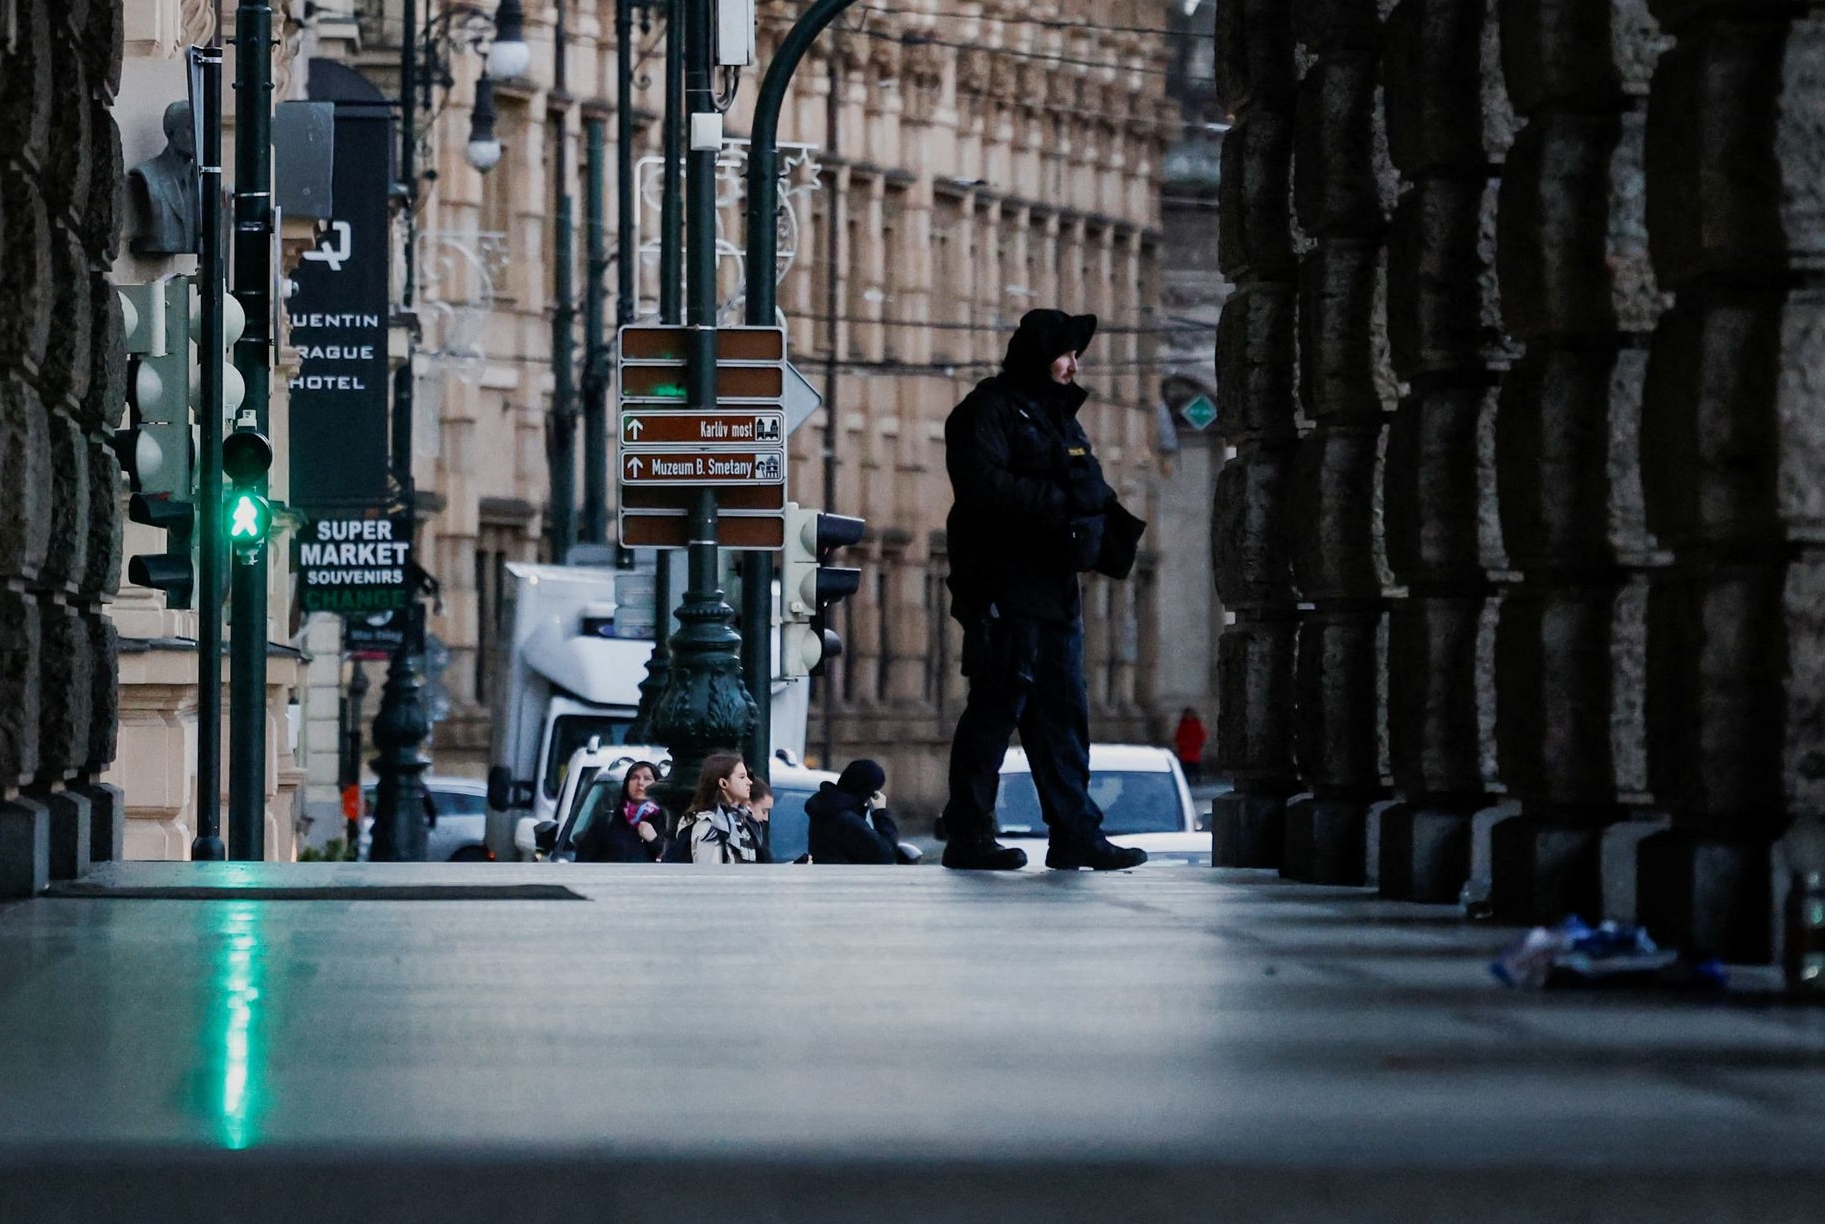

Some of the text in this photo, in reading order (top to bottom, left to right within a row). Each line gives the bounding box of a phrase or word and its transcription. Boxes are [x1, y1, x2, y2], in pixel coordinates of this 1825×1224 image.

[292, 313, 379, 328] UENTIN
[296, 345, 374, 360] RAGUE
[289, 376, 365, 390] HOTEL
[700, 420, 753, 438] Karlův most
[652, 458, 752, 479] Muzeum B. Smetany
[317, 520, 392, 541] SUPER
[300, 543, 409, 566] MARKET
[307, 570, 403, 585] SOUVENIRS
[306, 590, 405, 609] CHANGE
